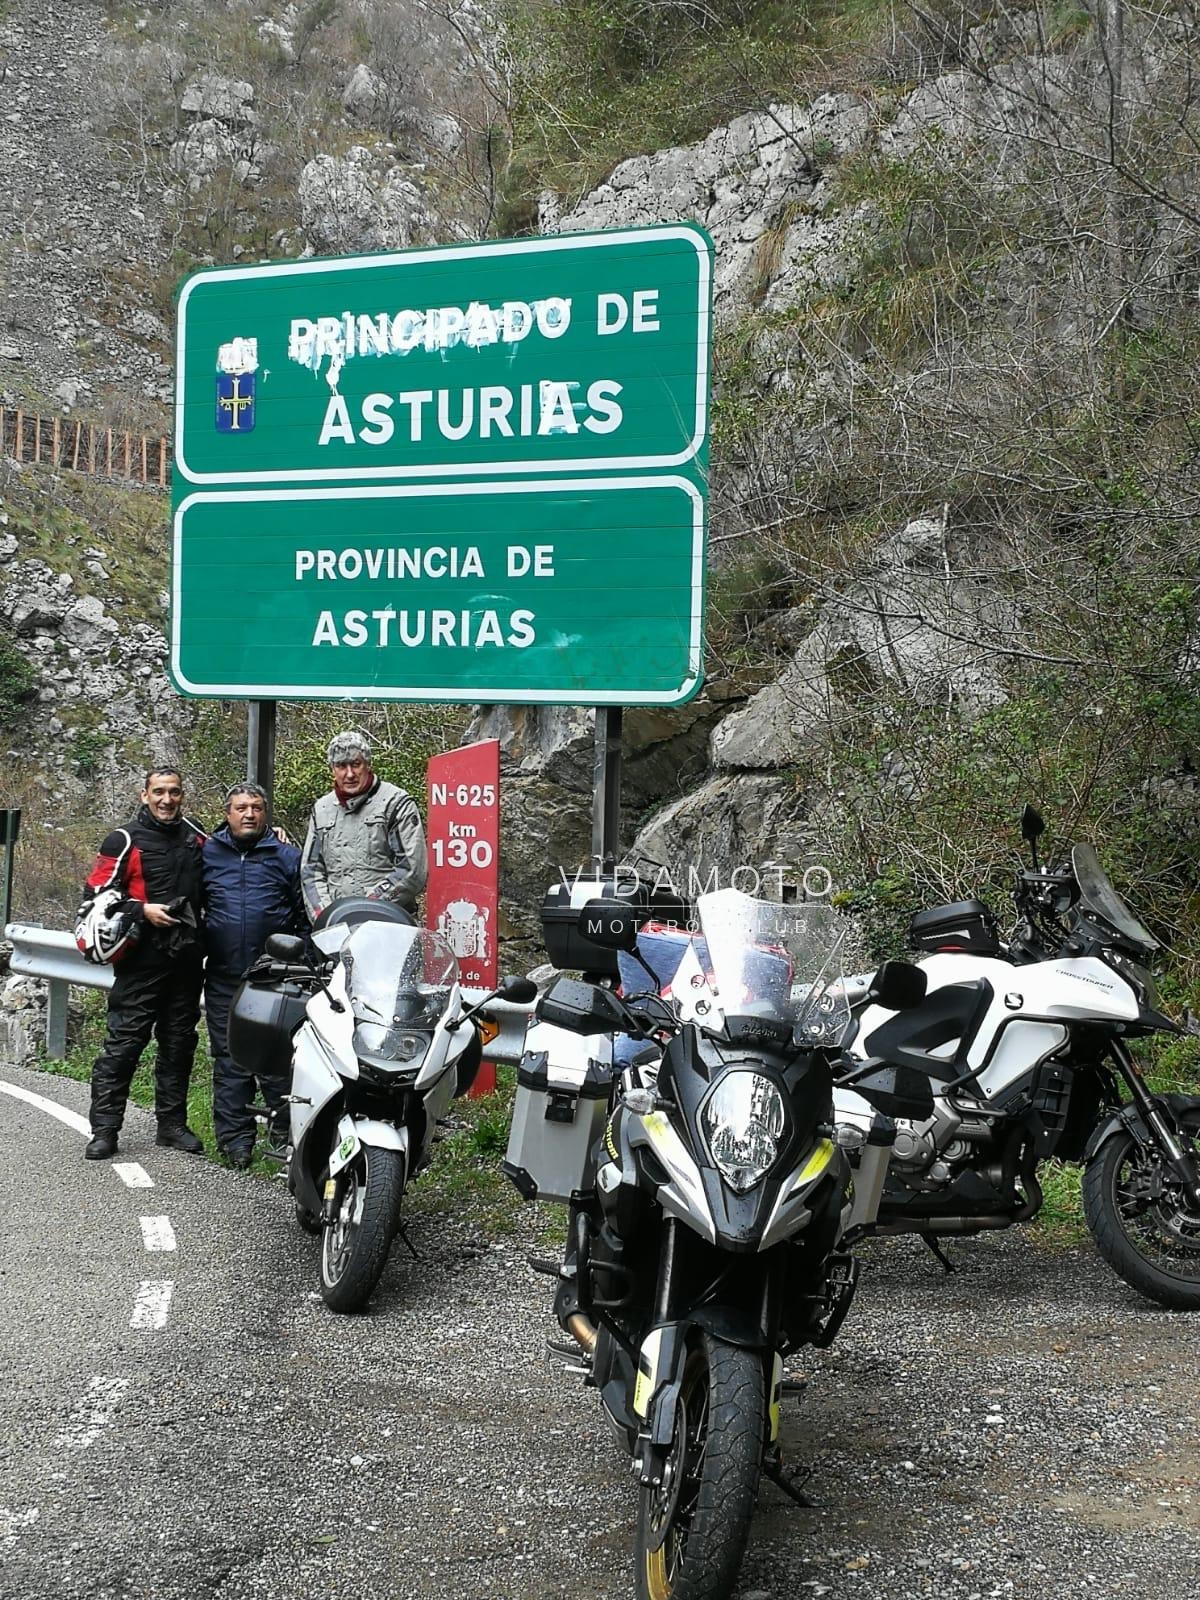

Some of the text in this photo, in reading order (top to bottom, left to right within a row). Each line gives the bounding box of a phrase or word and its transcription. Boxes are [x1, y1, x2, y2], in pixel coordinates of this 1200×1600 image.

[289, 289, 661, 356] PRINCIPADO DE
[318, 380, 624, 446] ASTURIAS
[295, 546, 555, 580] PROVINCIA DE
[312, 609, 536, 647] ASTURIAS
[431, 783, 495, 807] N-625
[448, 821, 477, 838] km
[432, 839, 493, 869] 130
[466, 970, 480, 980] de
